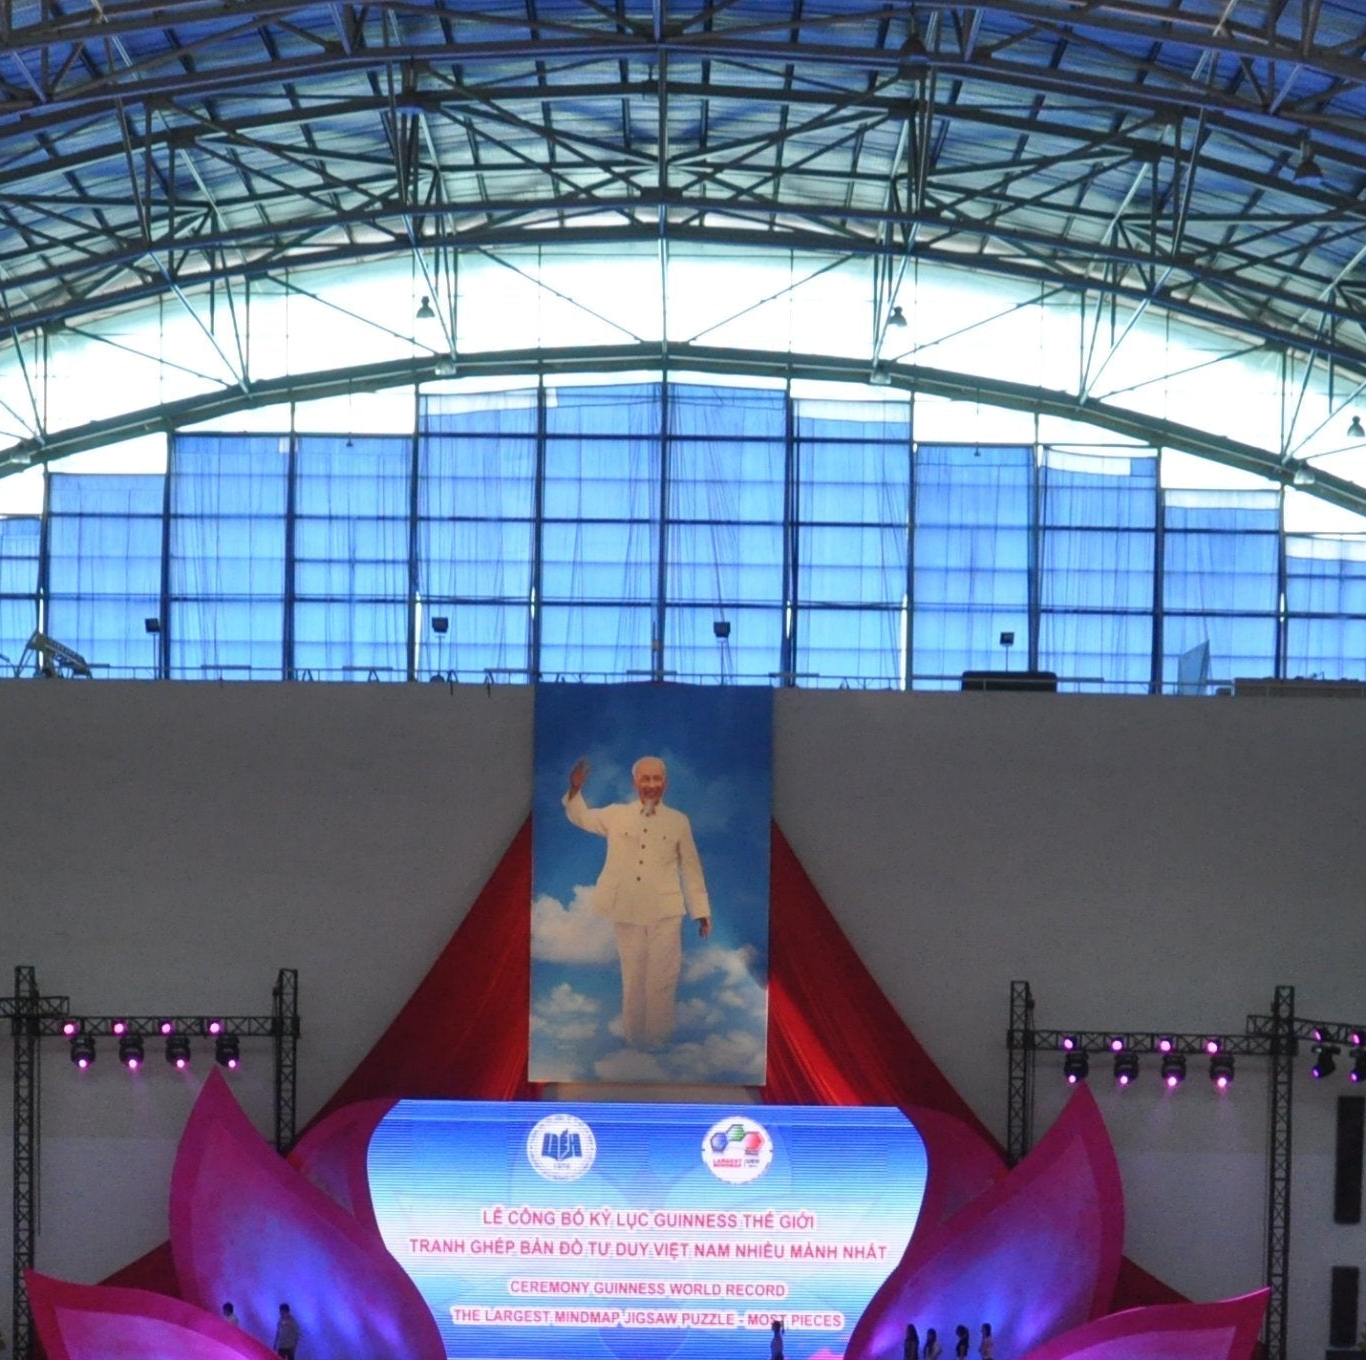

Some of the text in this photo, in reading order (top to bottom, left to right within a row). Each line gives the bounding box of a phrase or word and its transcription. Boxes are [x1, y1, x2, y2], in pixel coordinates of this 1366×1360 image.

[483, 1206, 814, 1230] LỄ CÔNG BỐ KỶ LỤC GUINNESS THẾ GIỚI
[410, 1239, 465, 1254] TRANH
[470, 1237, 515, 1255] GHÉP
[520, 1237, 554, 1256] BẢN
[588, 1241, 612, 1256] TƯ
[616, 1242, 649, 1257] DUY
[655, 1240, 689, 1260] VIỆT
[694, 1243, 730, 1258] NAM
[790, 1241, 838, 1260] MẢNH
[510, 1281, 785, 1297] CEREMONY GUINNESS WORLD RECORD
[454, 1309, 480, 1321] THE
[485, 1310, 551, 1322] LARGEST
[555, 1311, 619, 1324] MINDMAP
[624, 1311, 677, 1324] JIGSAW
[682, 1312, 735, 1325] PUZZLE
[791, 1315, 842, 1327] PIECES
